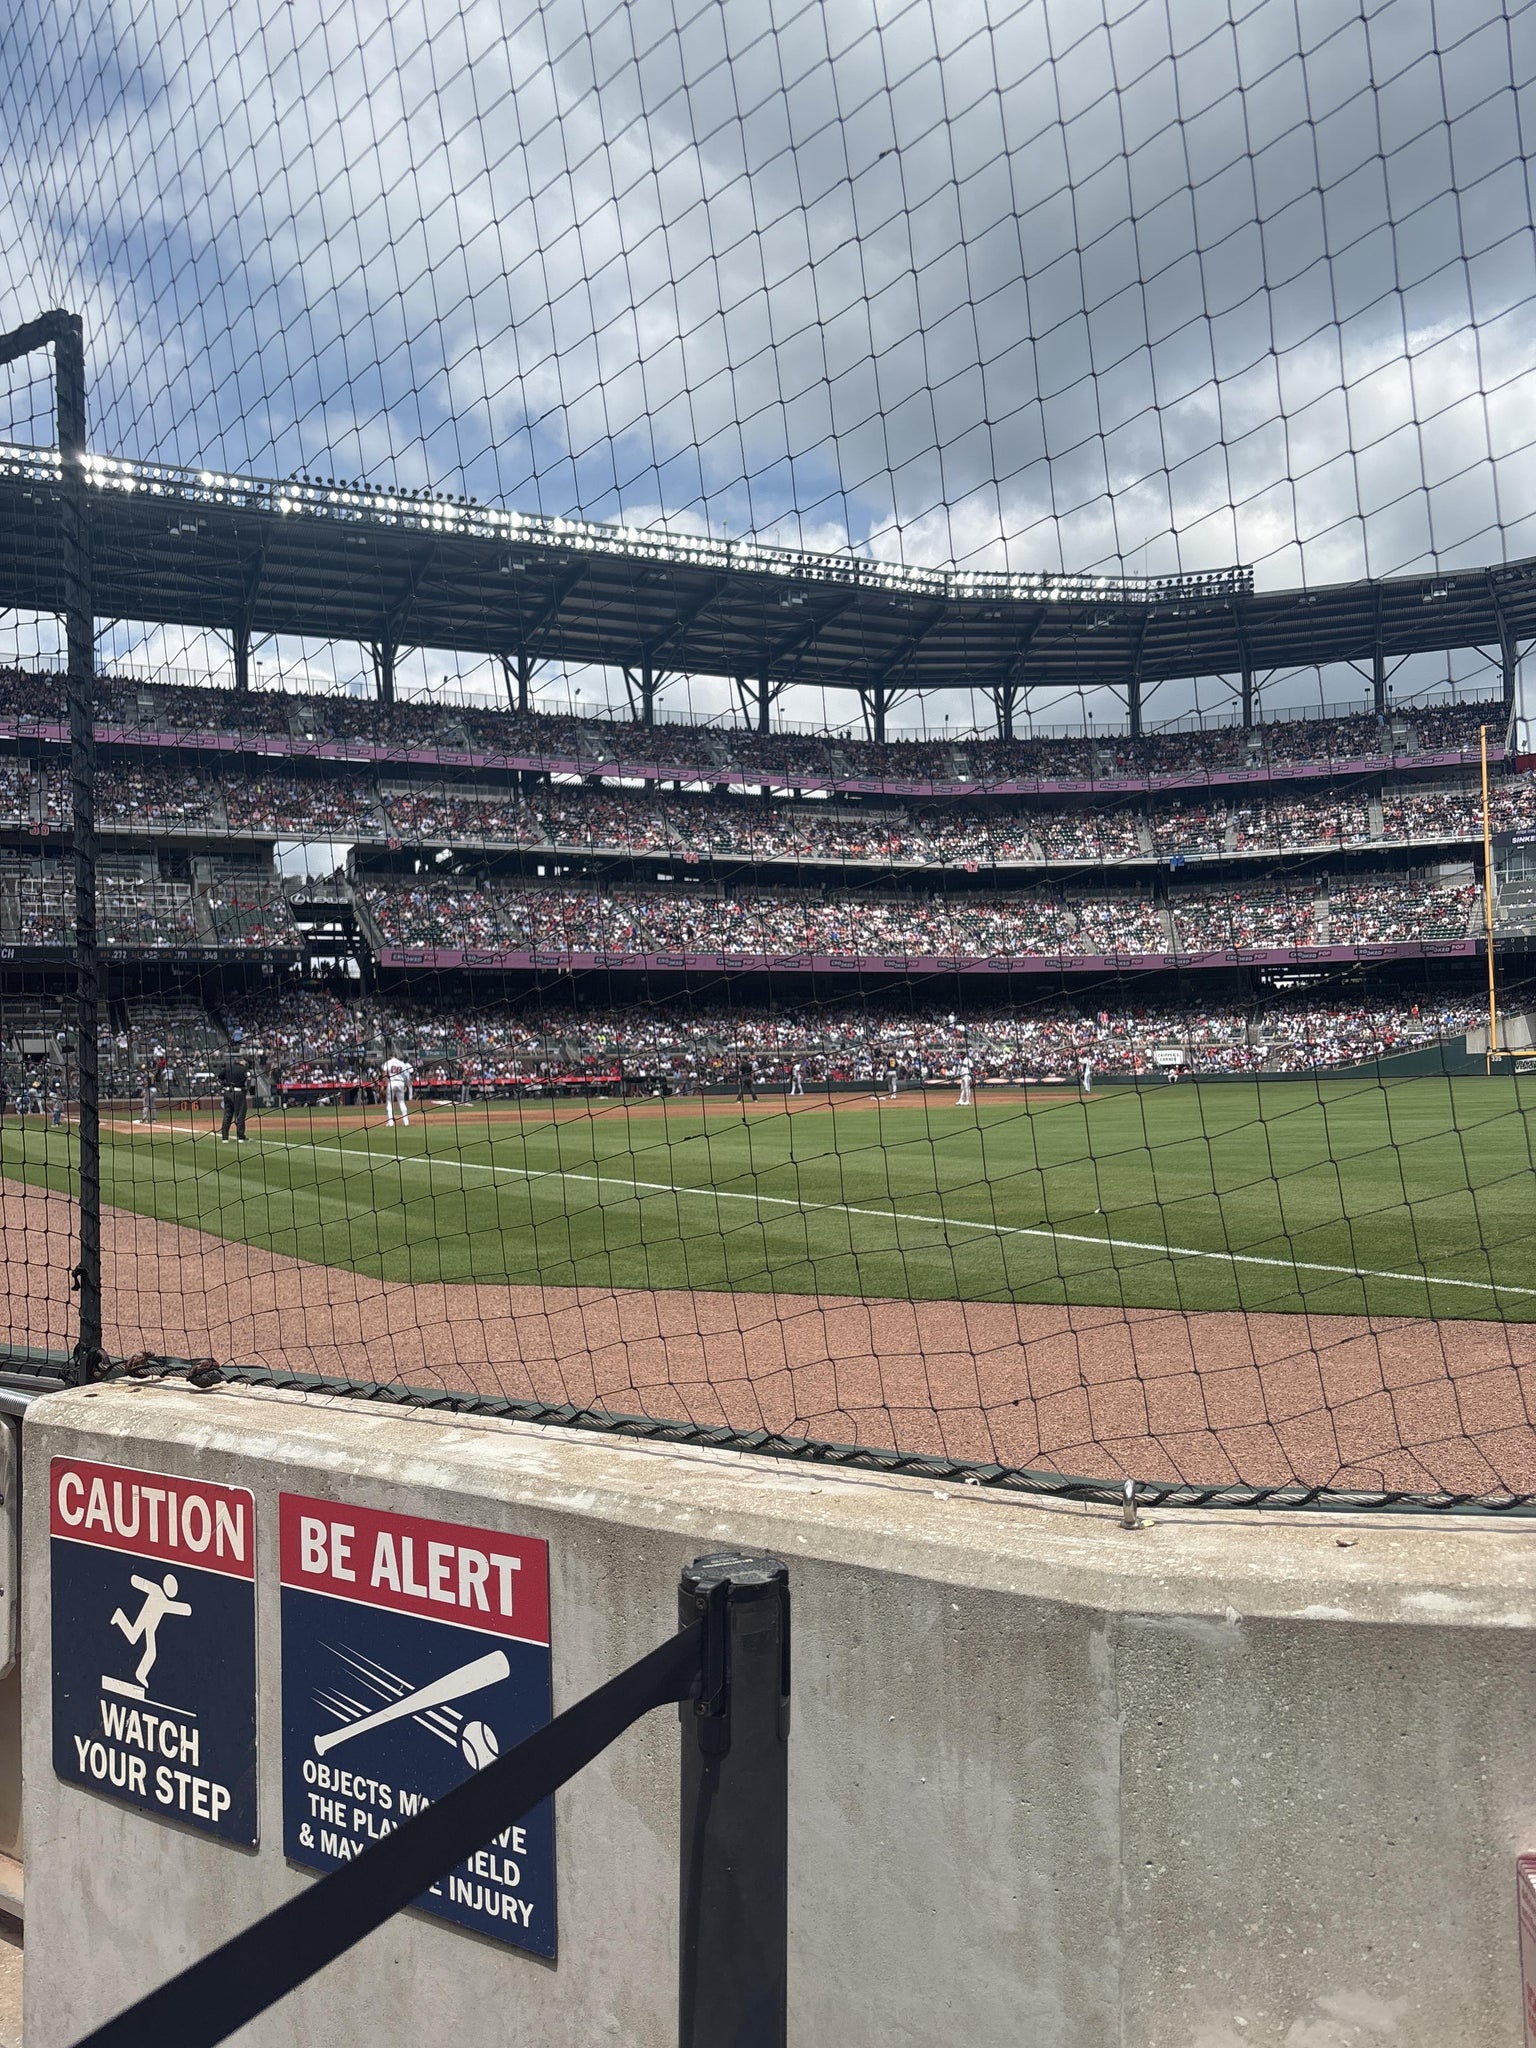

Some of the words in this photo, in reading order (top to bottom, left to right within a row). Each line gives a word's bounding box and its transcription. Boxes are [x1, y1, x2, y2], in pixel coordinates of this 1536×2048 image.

[58, 1471, 245, 1562] CAUTION
[300, 1516, 356, 1582] BE
[370, 1531, 522, 1617] ALERT
[74, 1735, 147, 1796] YOUR
[155, 1765, 231, 1822] STEP
[100, 1699, 199, 1767] WATCH
[302, 1759, 393, 1810] OBJECTS
[399, 1789, 435, 1817] MA
[299, 1822, 315, 1849] &
[449, 1875, 534, 1928] INJURY
[308, 1792, 347, 1828] THE
[467, 1851, 521, 1887] IELD
